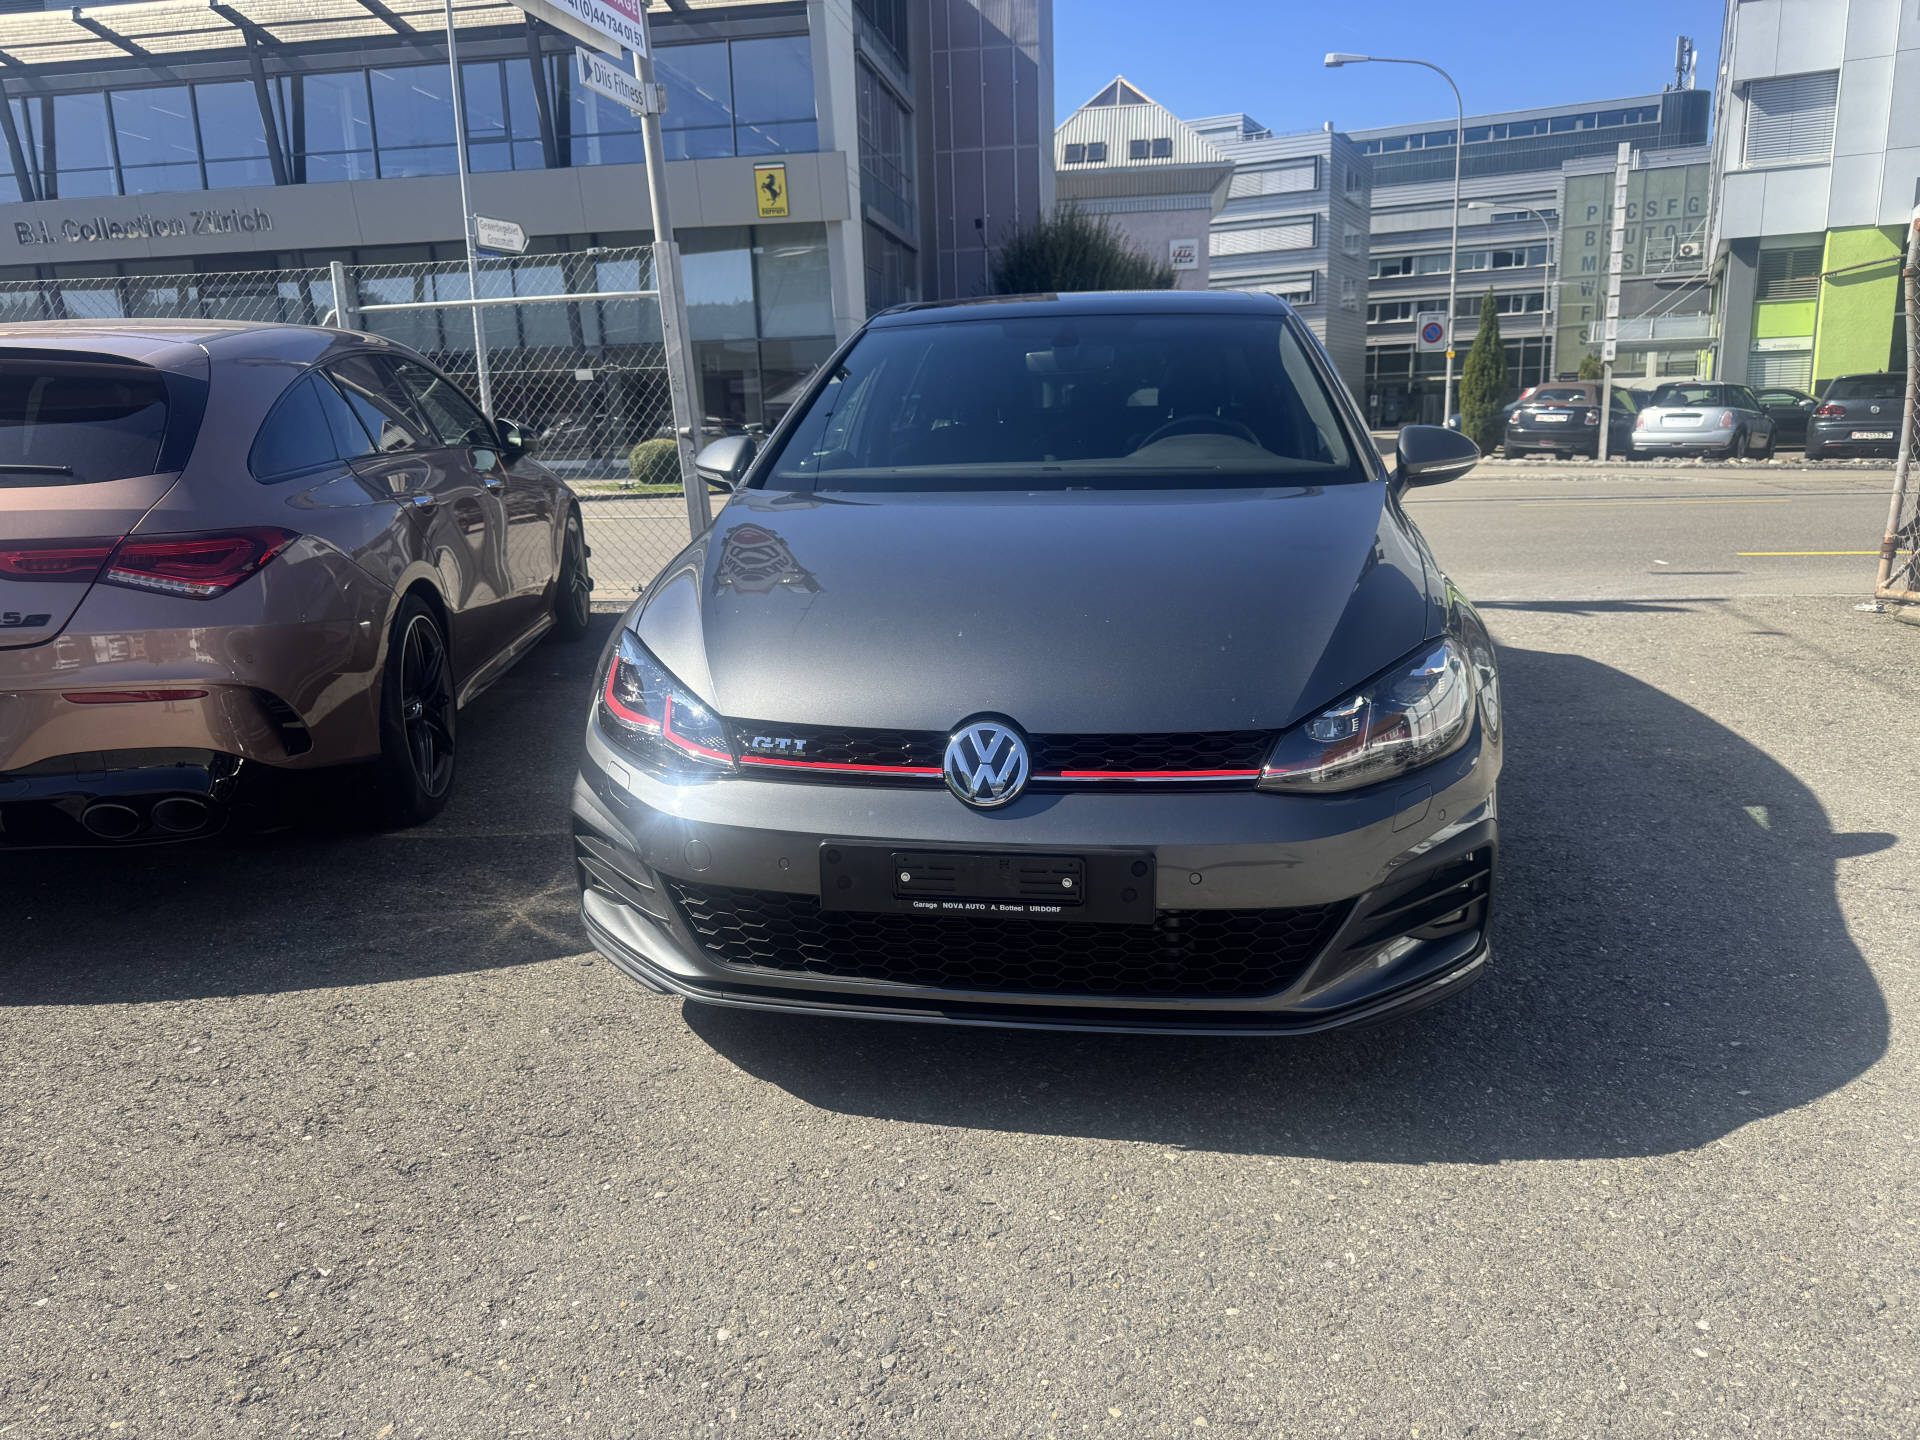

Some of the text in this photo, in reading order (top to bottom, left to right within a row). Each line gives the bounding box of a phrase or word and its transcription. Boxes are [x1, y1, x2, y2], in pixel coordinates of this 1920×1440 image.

[606, 14, 624, 37] 734
[624, 25, 634, 44] 01
[634, 31, 644, 48] 51
[613, 72, 644, 107] Fitness
[62, 213, 187, 243] Collection
[189, 207, 273, 236] Zürich
[751, 736, 807, 757] GTI
[912, 901, 938, 909] Garage
[942, 902, 964, 910] NOVA
[1029, 905, 1062, 913] URDORF
